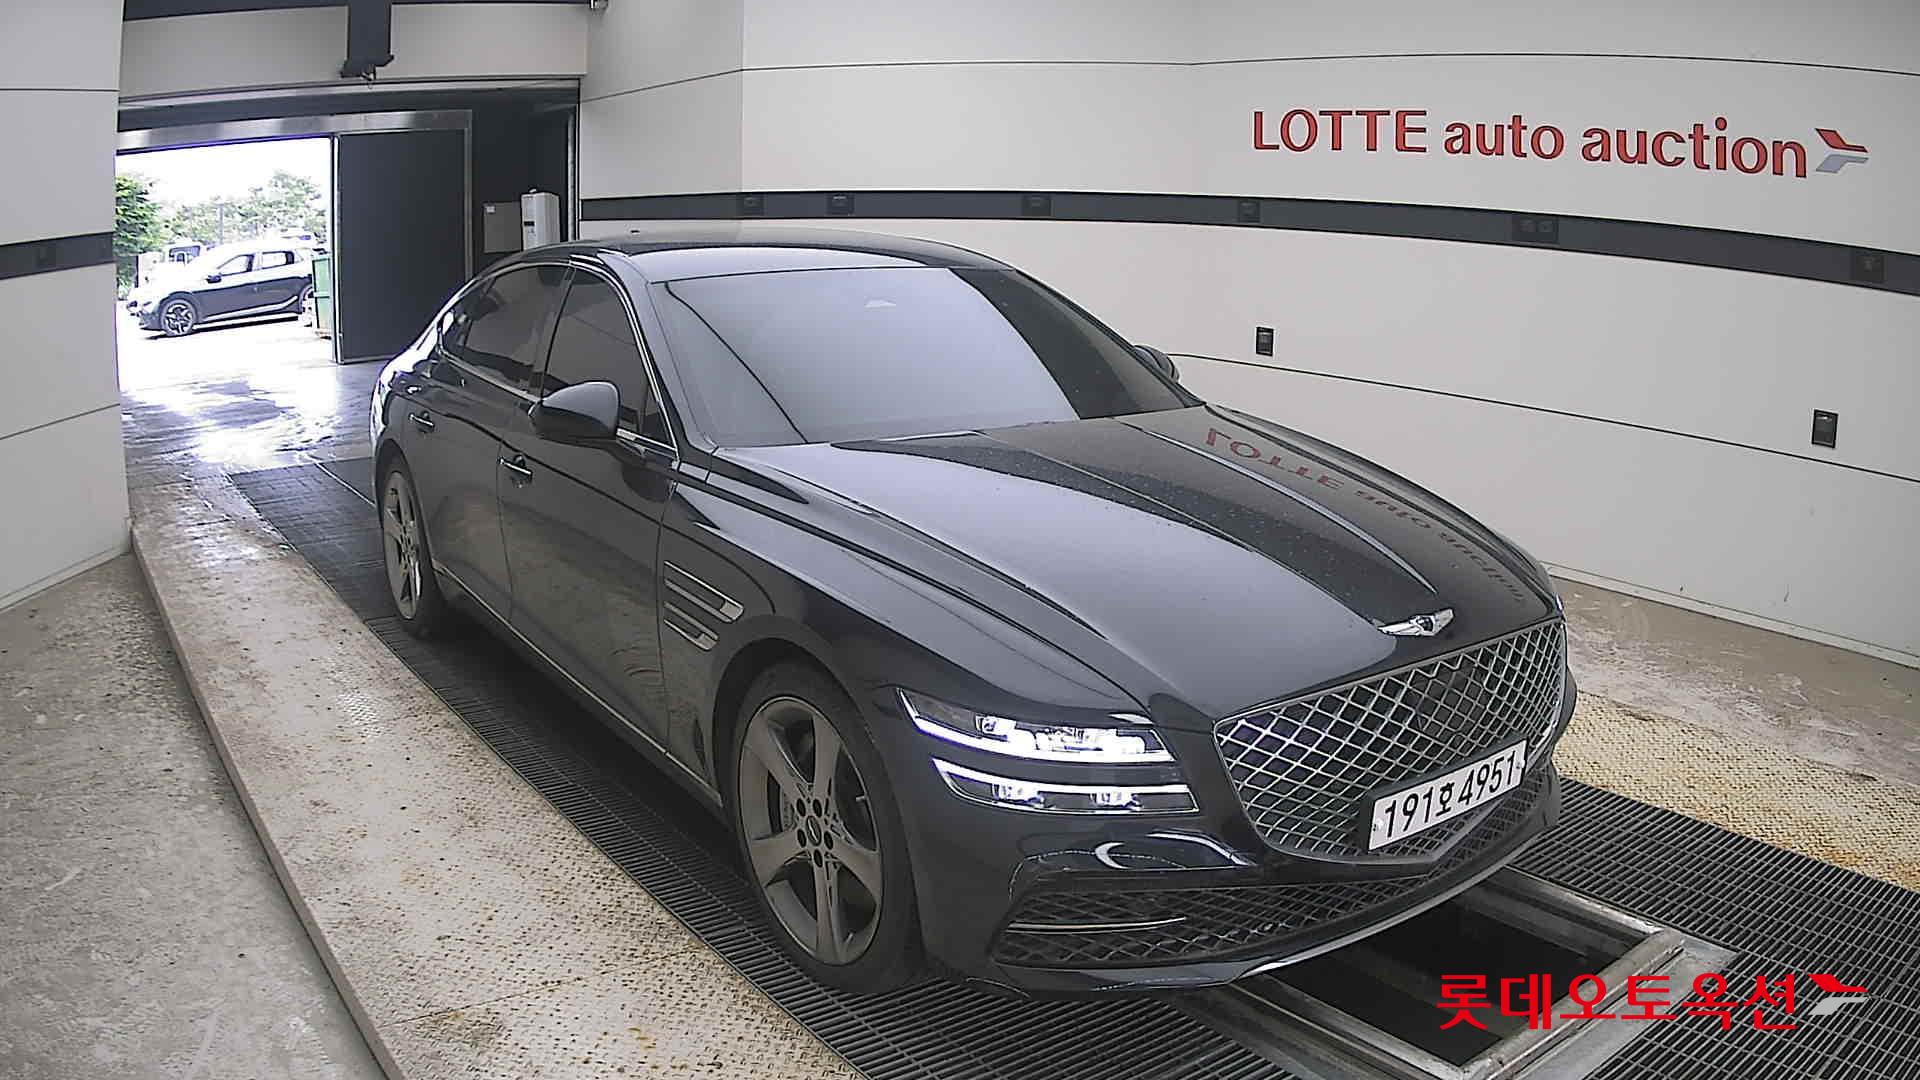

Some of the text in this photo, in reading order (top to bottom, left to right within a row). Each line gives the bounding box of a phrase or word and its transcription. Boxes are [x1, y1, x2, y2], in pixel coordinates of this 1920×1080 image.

[1252, 109, 1808, 178] LOTTE auto auction
